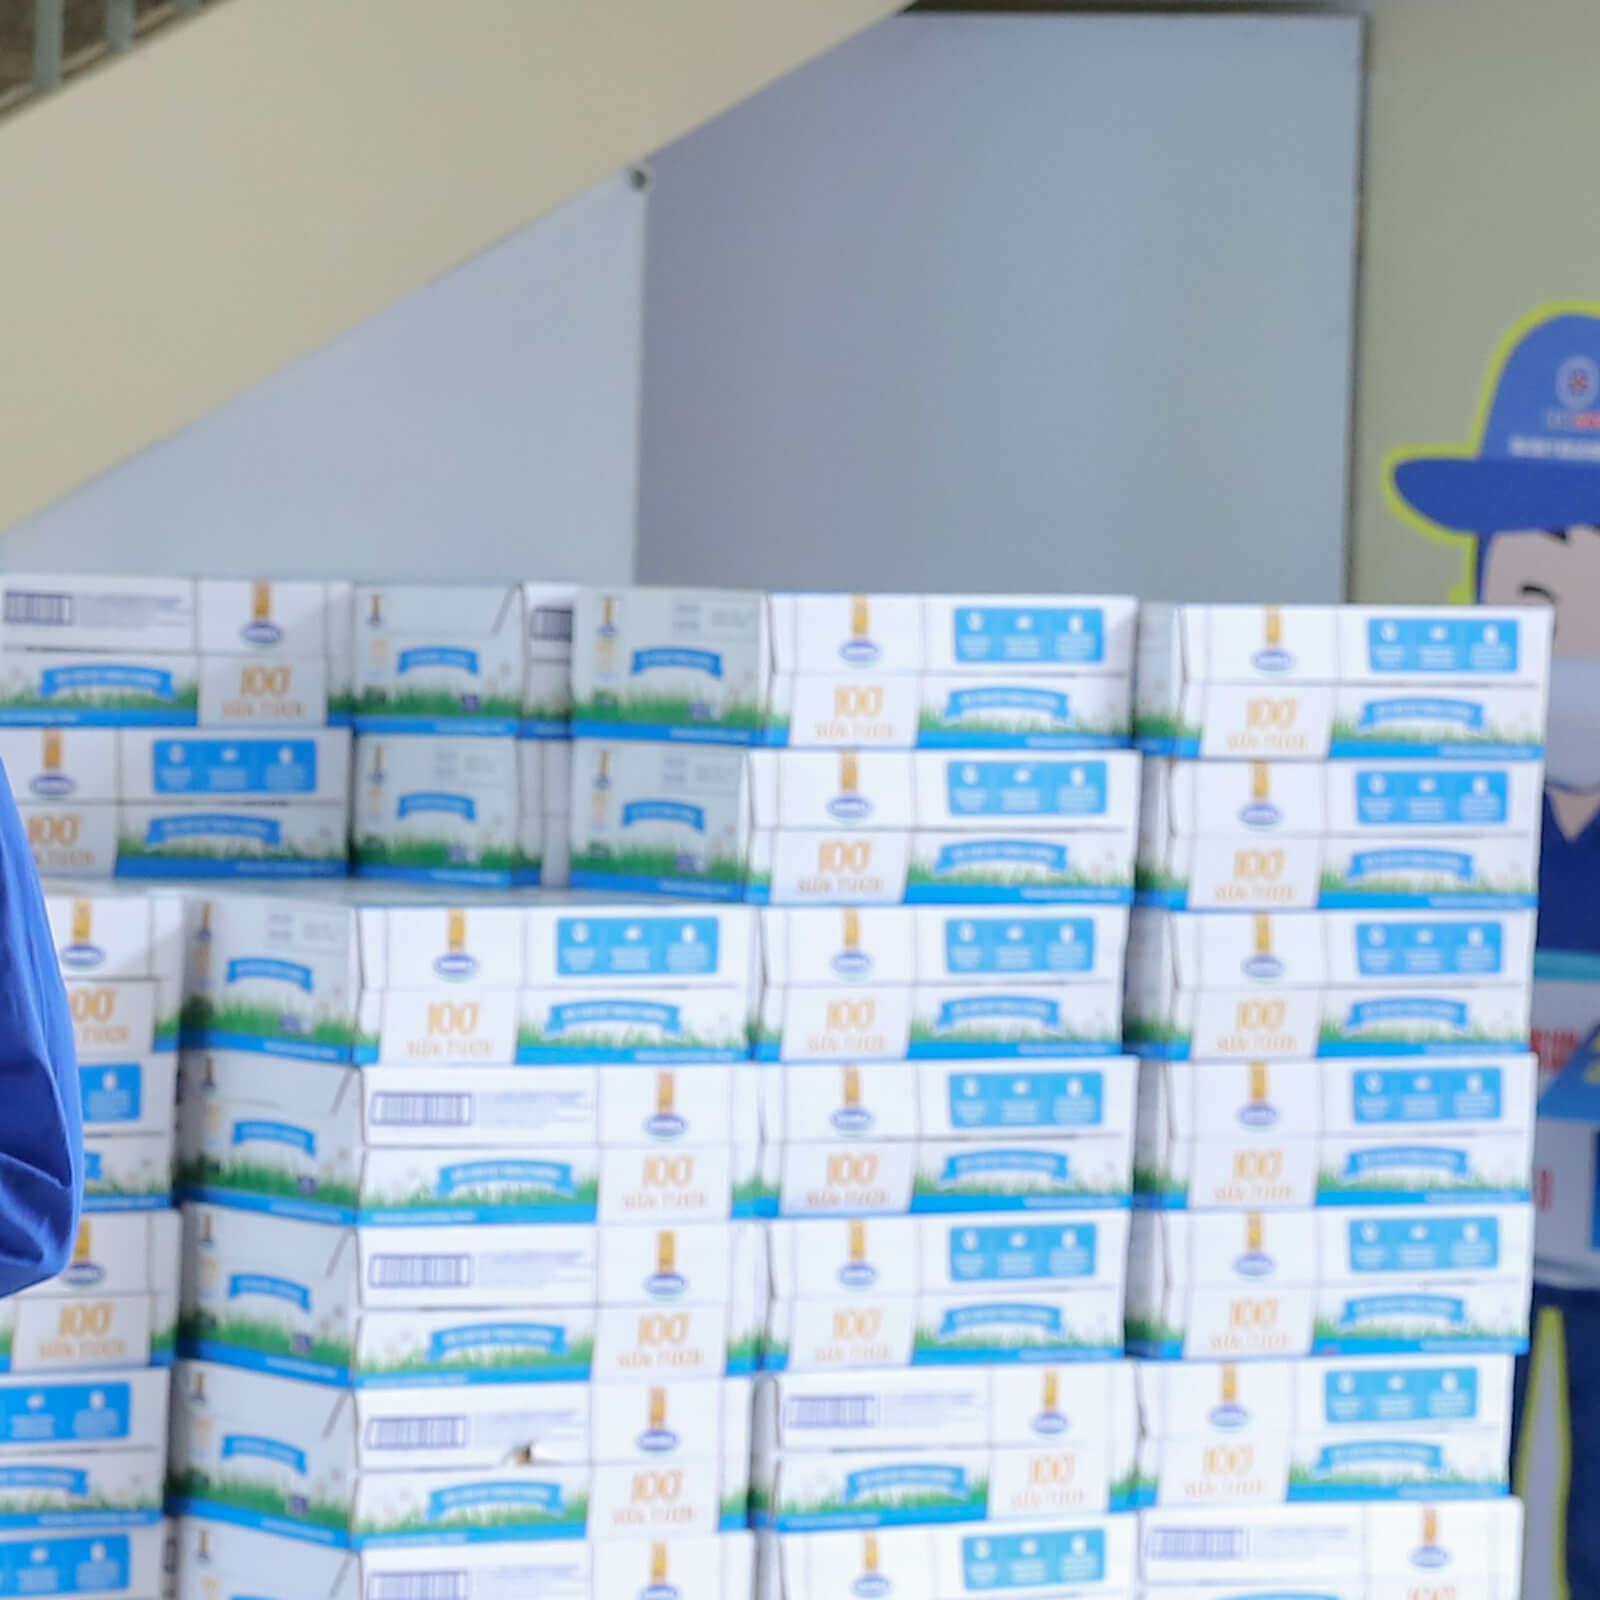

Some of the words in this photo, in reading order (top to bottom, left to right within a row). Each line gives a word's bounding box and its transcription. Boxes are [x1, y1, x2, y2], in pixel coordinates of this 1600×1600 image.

[241, 667, 289, 696] 100
[836, 687, 883, 716] 100
[1248, 699, 1296, 727] 100
[30, 816, 80, 844] 100
[820, 841, 871, 871] 100
[1236, 851, 1284, 879] 100
[71, 989, 115, 1022] 00
[429, 1003, 478, 1033] 100
[60, 1304, 113, 1336] 100
